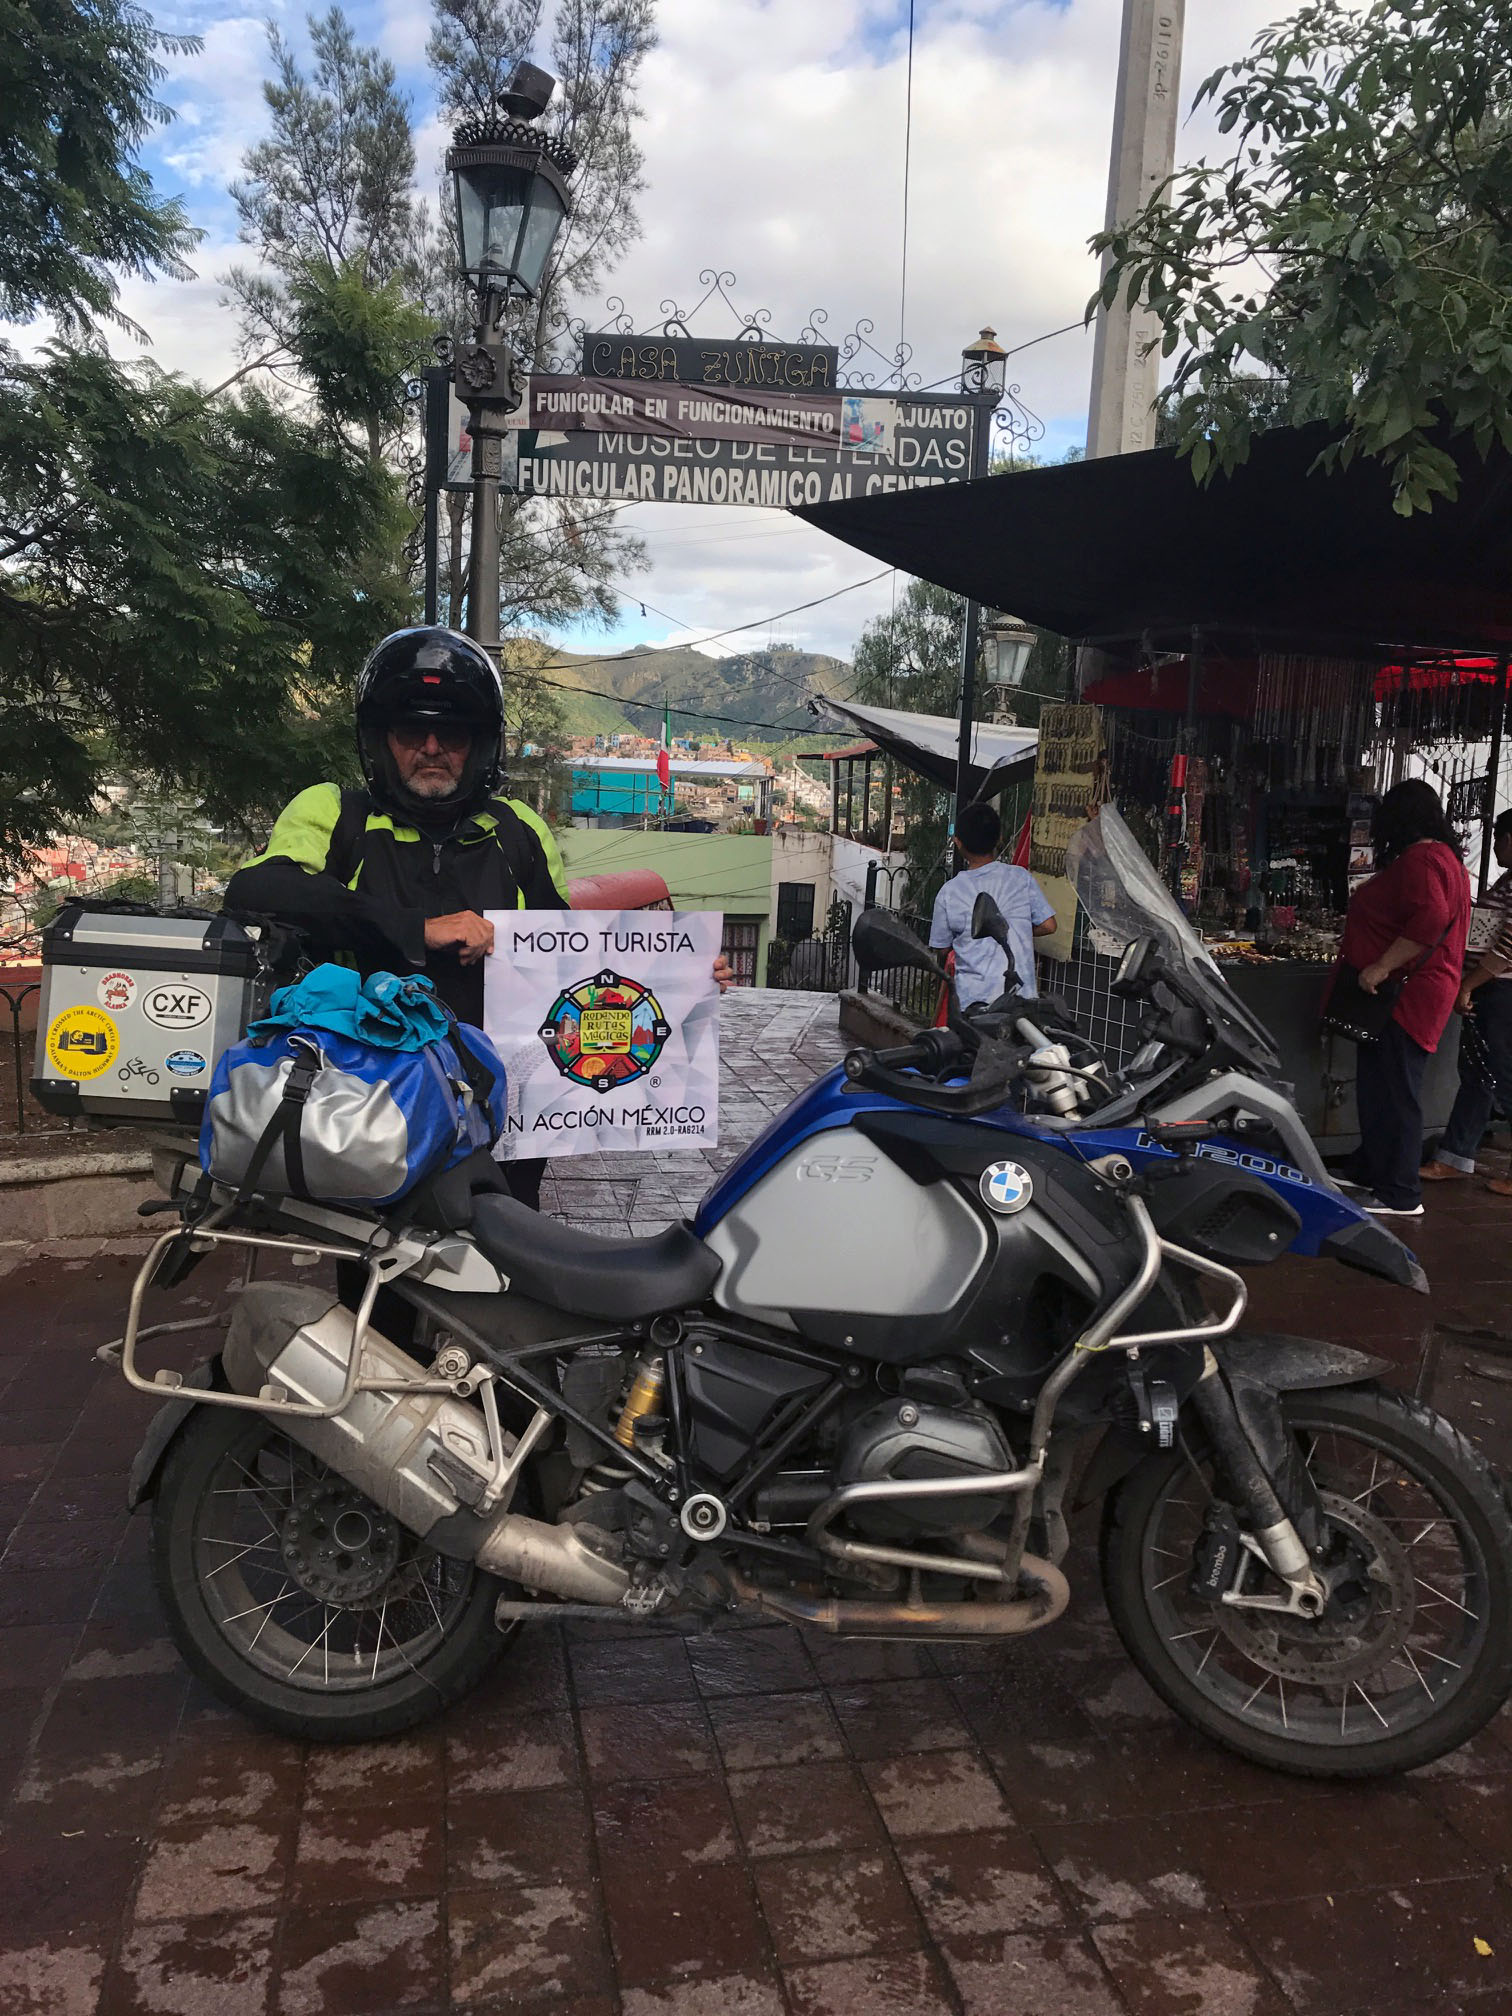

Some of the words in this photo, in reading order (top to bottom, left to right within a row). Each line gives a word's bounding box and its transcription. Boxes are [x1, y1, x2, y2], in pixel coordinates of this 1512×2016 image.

[592, 341, 680, 380] CASA
[536, 392, 634, 416] FUNICULAR
[645, 398, 667, 419] EN
[678, 400, 834, 432] FUNCIONAMIENTO
[598, 431, 721, 459] MUSEO
[731, 440, 776, 461] DE
[519, 457, 656, 499] FUNICULAR
[663, 464, 822, 507] PANORAMICO
[513, 931, 589, 952] MOTO
[599, 931, 695, 952] TURISTA
[600, 974, 614, 984] N
[152, 992, 202, 1014] CXF
[51, 1013, 72, 1036] CROSSED
[86, 1010, 107, 1023] ARCTIC
[541, 1028, 556, 1037] O
[656, 1026, 668, 1036] E
[598, 1078, 609, 1088] S
[502, 1114, 525, 1134] N
[532, 1105, 614, 1133] ACCIÓN
[621, 1103, 706, 1127] MÉXICO
[646, 1126, 662, 1136] RRM
[796, 1155, 878, 1183] GS
[988, 1162, 1031, 1184] BMW
[1206, 1545, 1227, 1587] brembo
